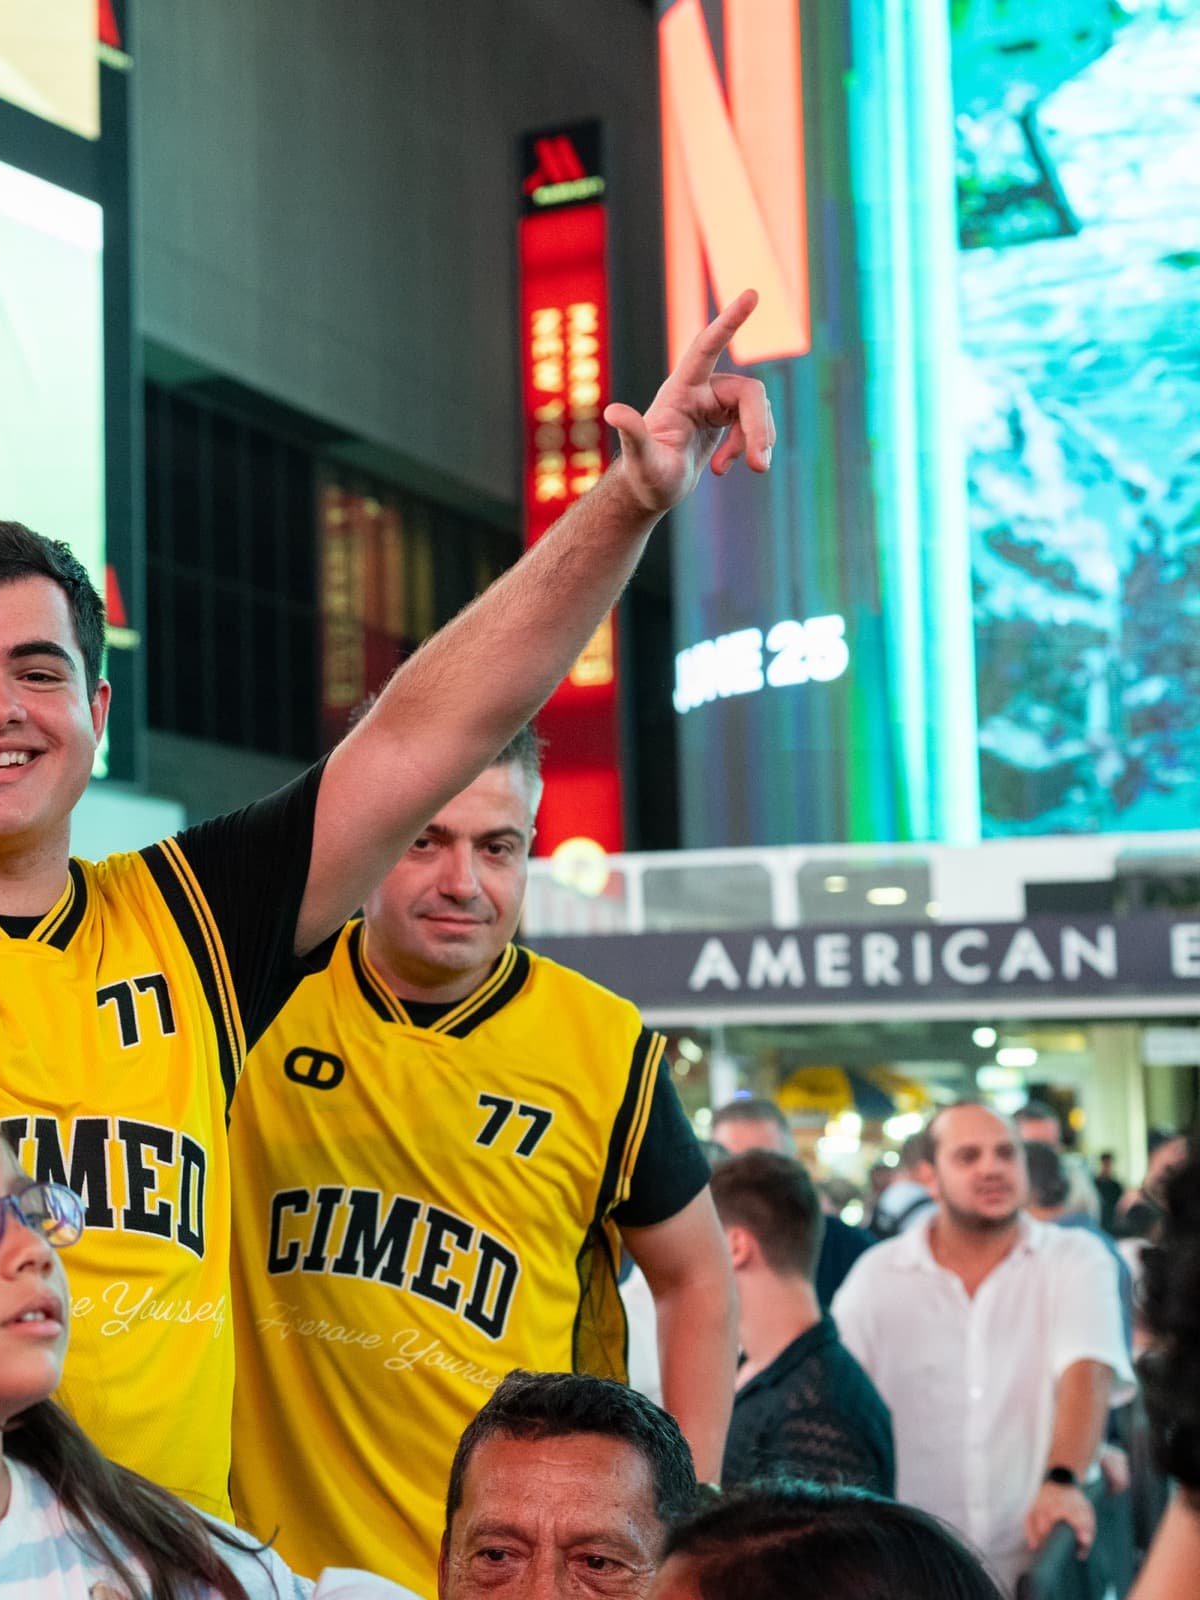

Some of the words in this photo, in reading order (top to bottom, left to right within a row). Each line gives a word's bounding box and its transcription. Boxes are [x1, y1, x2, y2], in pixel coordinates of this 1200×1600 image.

[766, 614, 849, 687] 25
[688, 925, 1118, 990] AMERICAN
[96, 971, 177, 1049] 77
[474, 1091, 555, 1158] 77
[267, 1184, 522, 1343] CIMED
